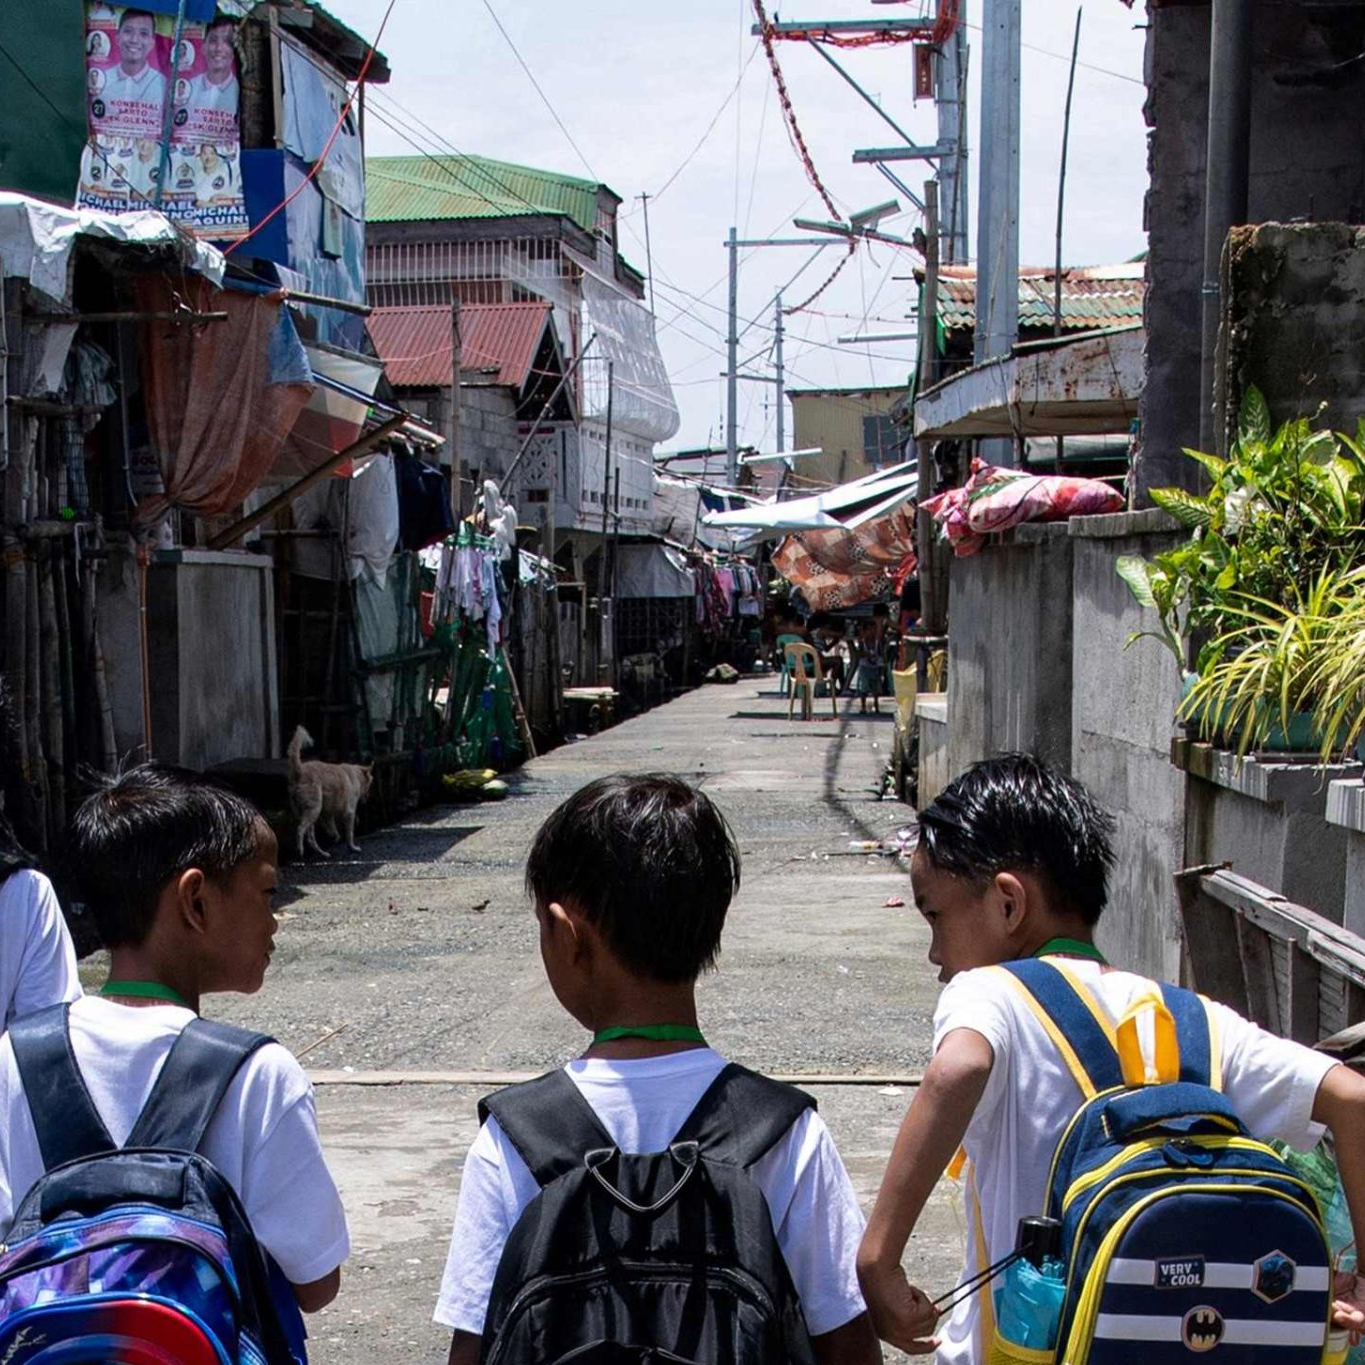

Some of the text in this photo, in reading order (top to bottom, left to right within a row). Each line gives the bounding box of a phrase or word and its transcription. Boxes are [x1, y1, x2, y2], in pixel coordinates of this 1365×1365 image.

[194, 109, 233, 118] KONSEH
[78, 192, 126, 209] ICHAEL
[193, 205, 246, 217] MICHAE
[1160, 1263, 1192, 1275] VERY
[1170, 1273, 1201, 1286] COOL
